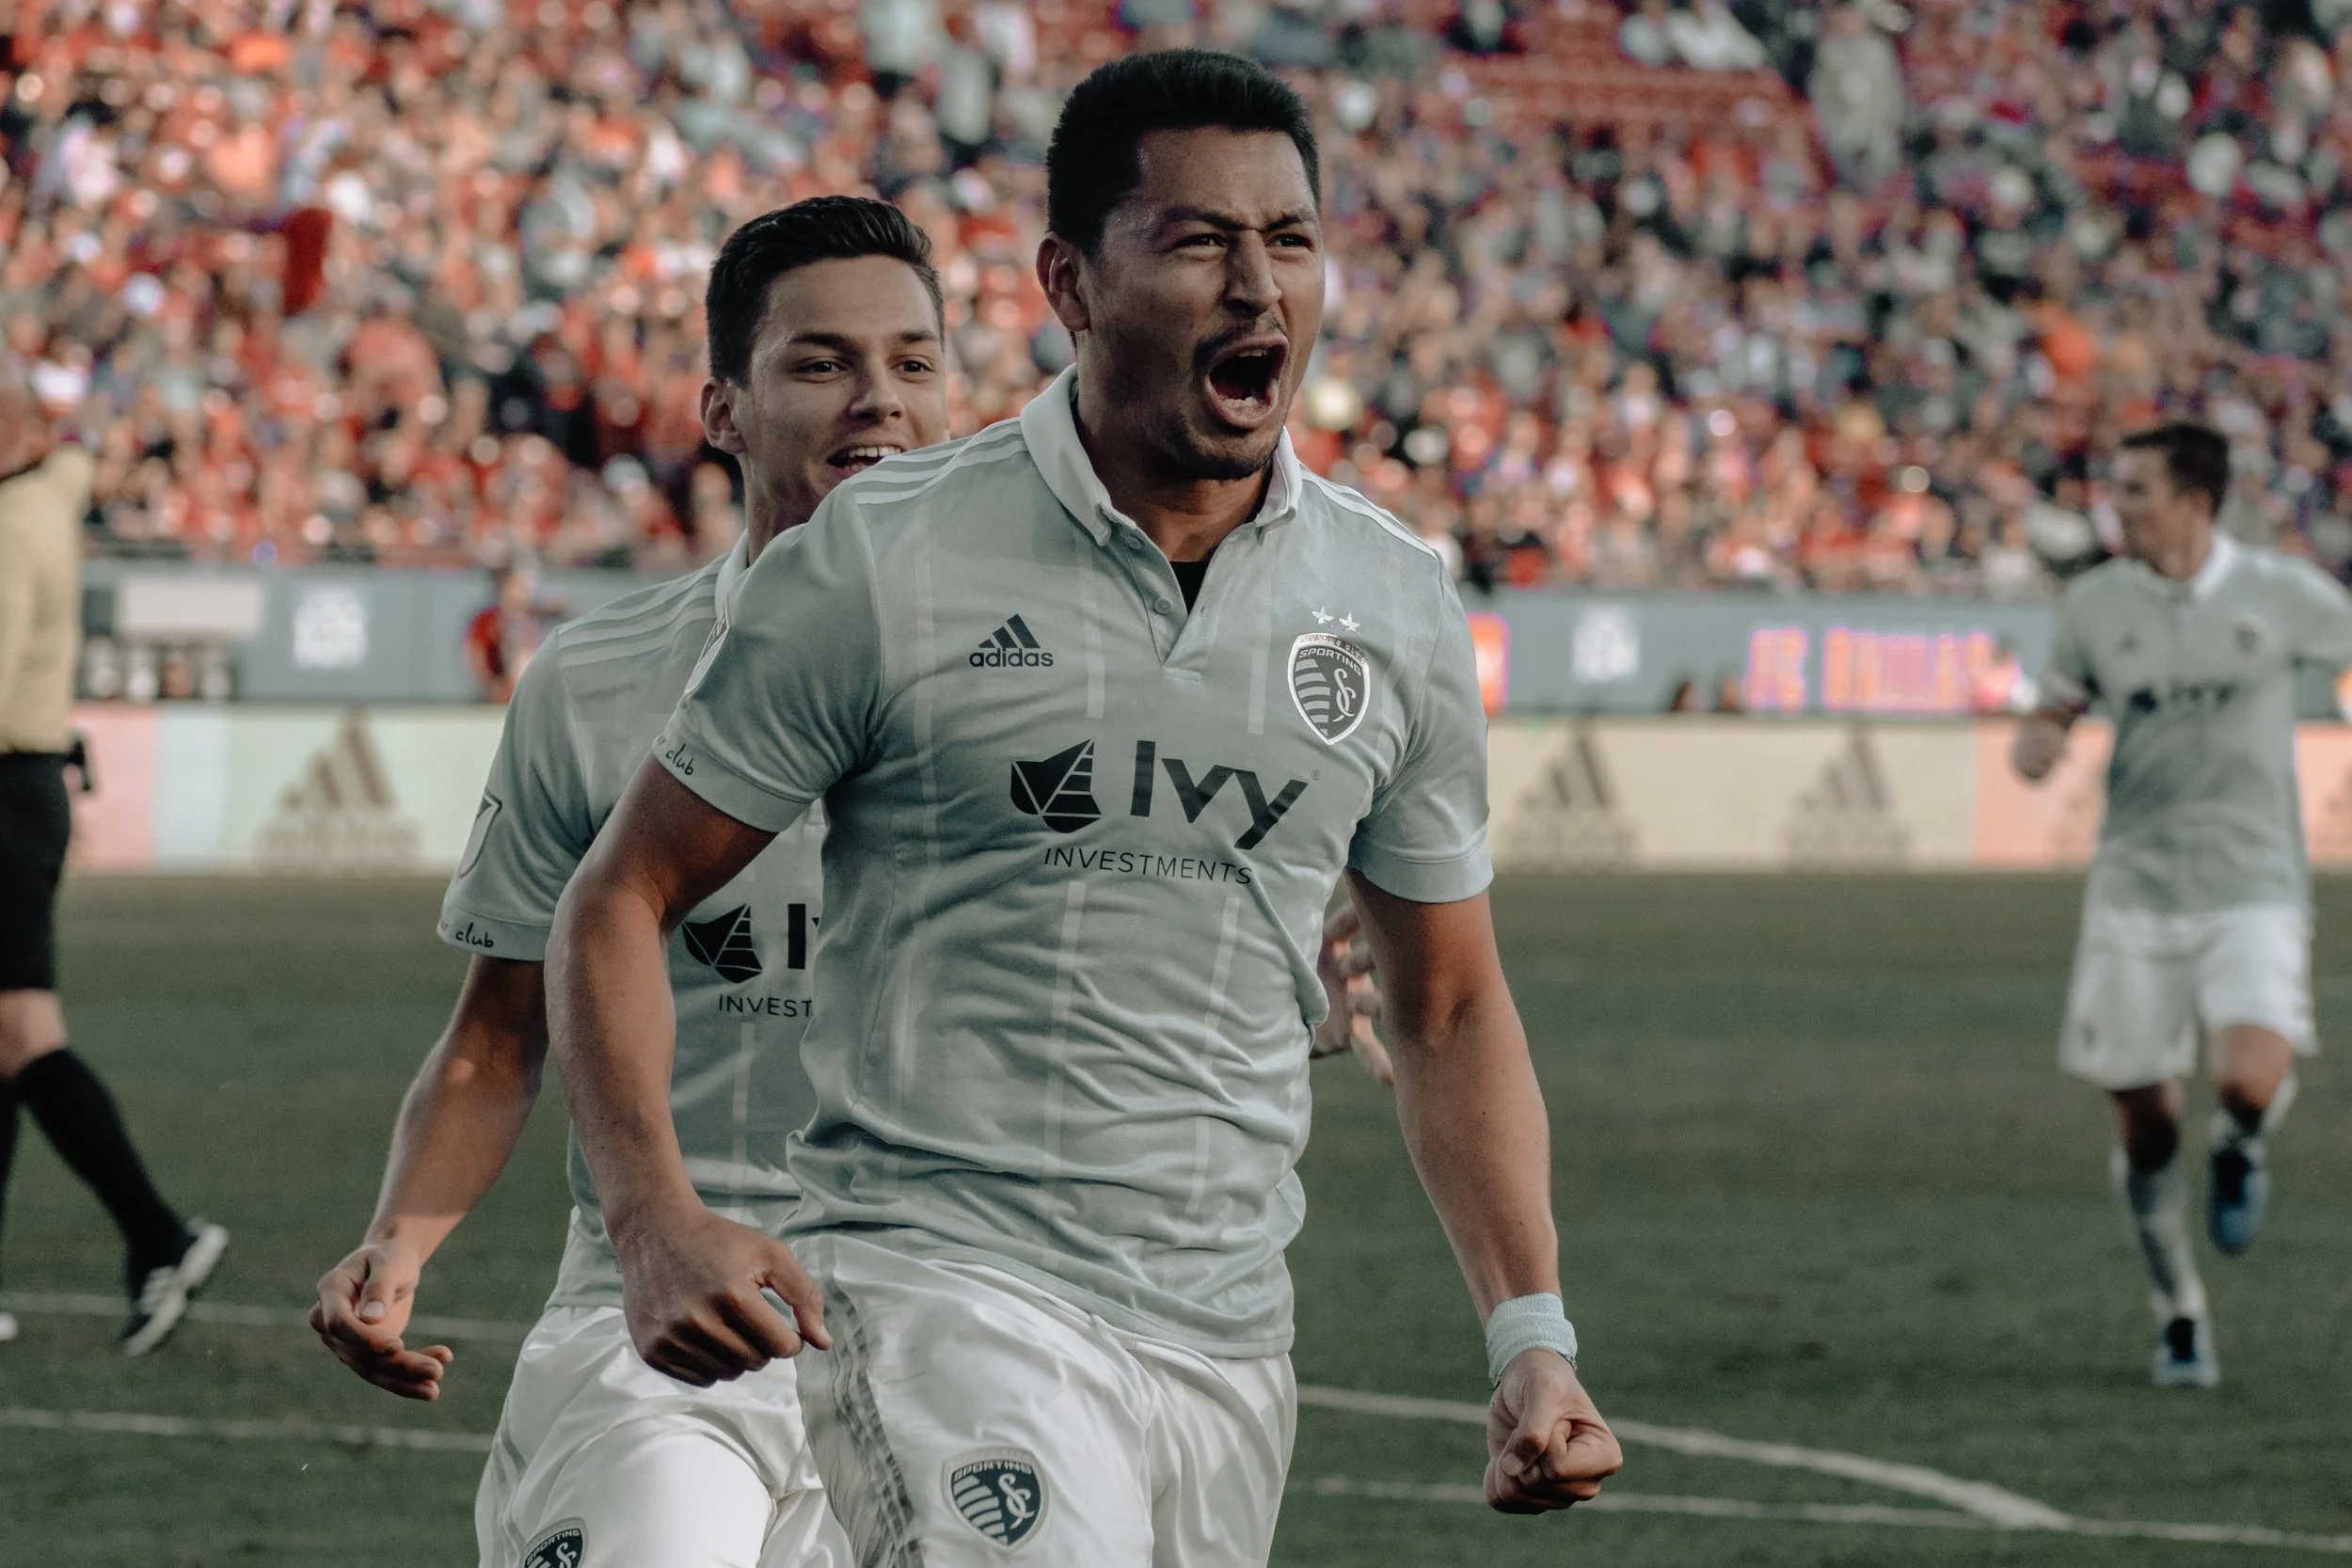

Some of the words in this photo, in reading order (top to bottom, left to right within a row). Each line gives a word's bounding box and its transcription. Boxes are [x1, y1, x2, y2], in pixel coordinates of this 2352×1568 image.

[968, 647, 1055, 668] adidas
[1298, 647, 1362, 676] SPORTING
[665, 742, 695, 776] club
[1129, 739, 1310, 851] Ivy
[1043, 847, 1254, 886] INVESTMENTS
[455, 921, 495, 948] club
